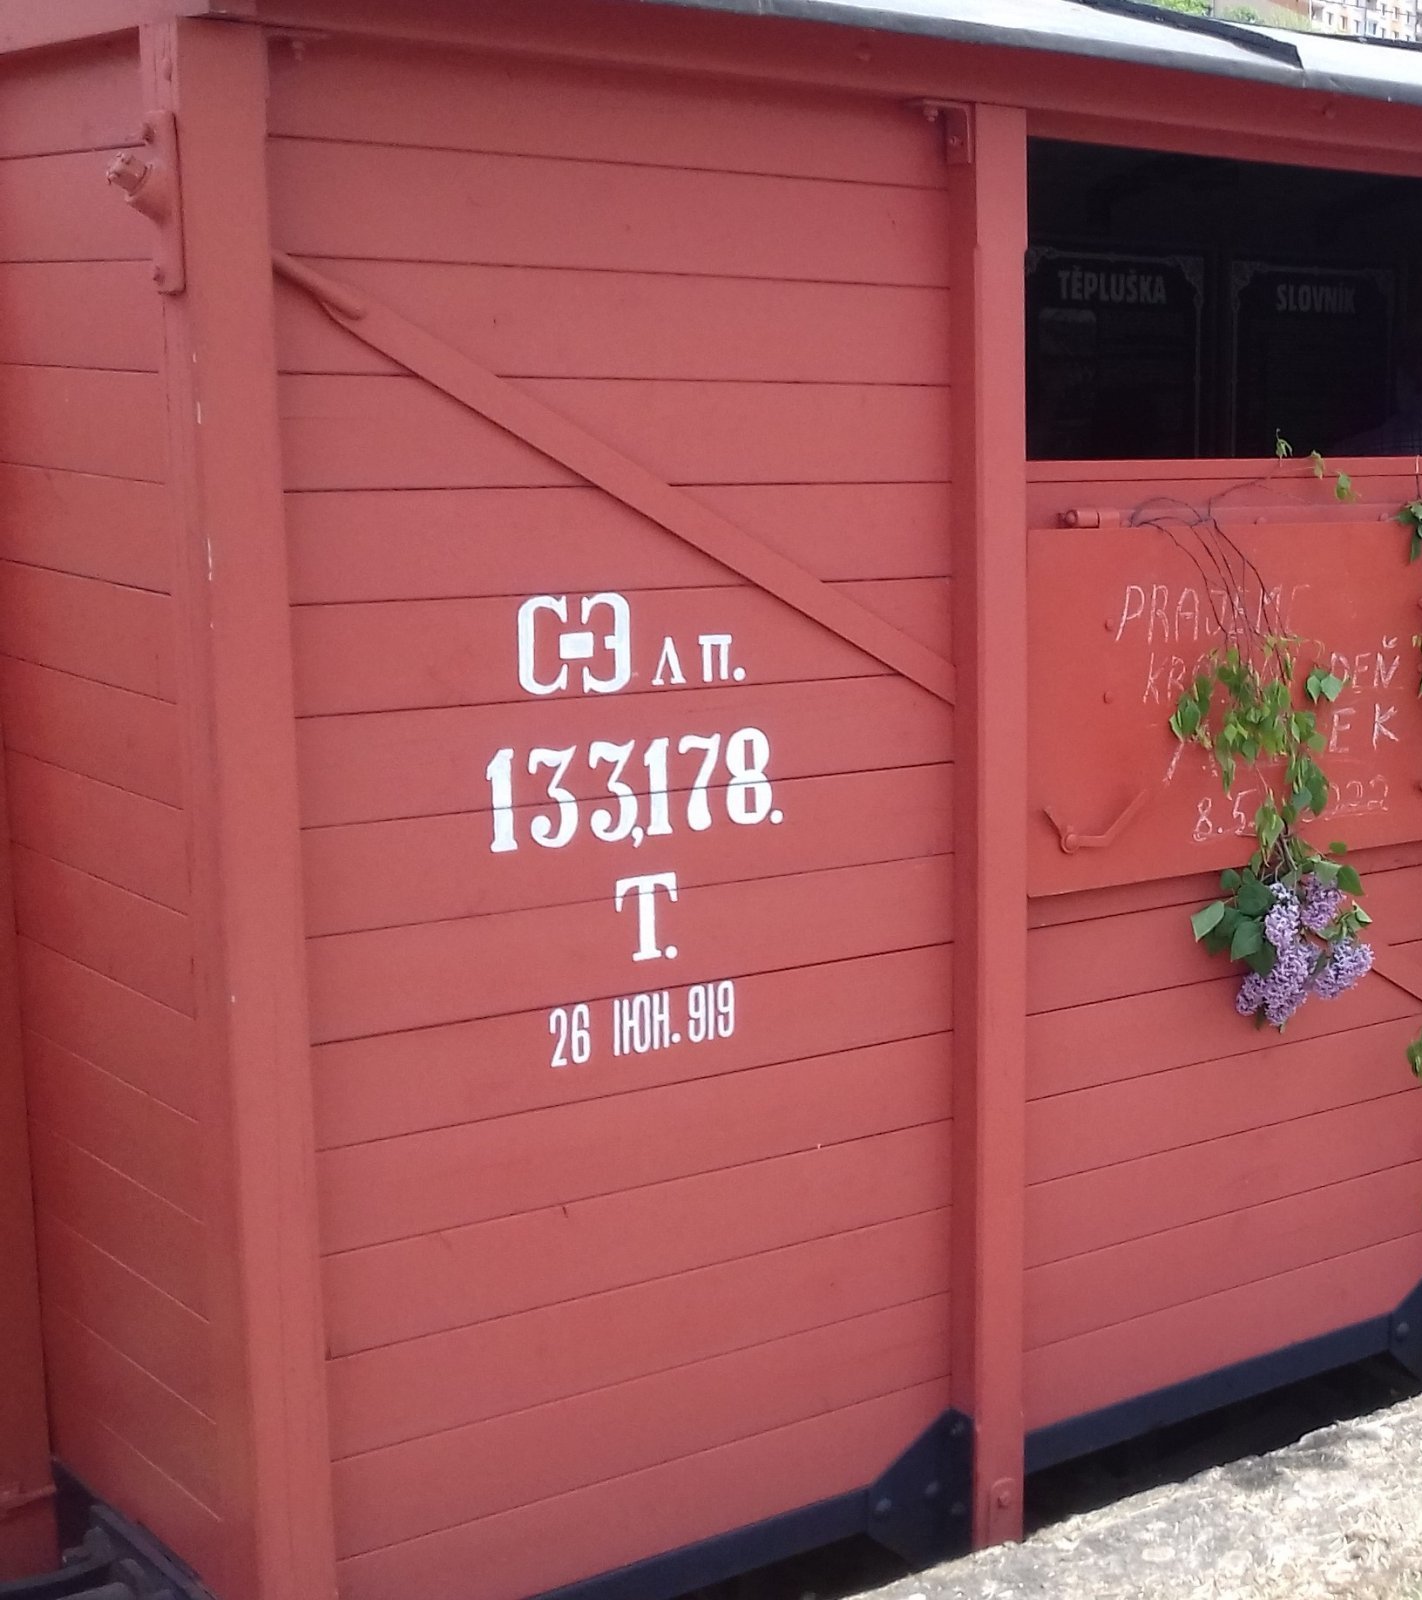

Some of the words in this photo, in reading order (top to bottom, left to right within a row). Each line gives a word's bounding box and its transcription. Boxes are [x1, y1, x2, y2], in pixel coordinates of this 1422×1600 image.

[1058, 264, 1167, 305] TĚPLUŠKA
[1275, 283, 1356, 315] SLOVNÍK
[486, 727, 784, 853] 133,178.
[549, 1003, 591, 1068] 26
